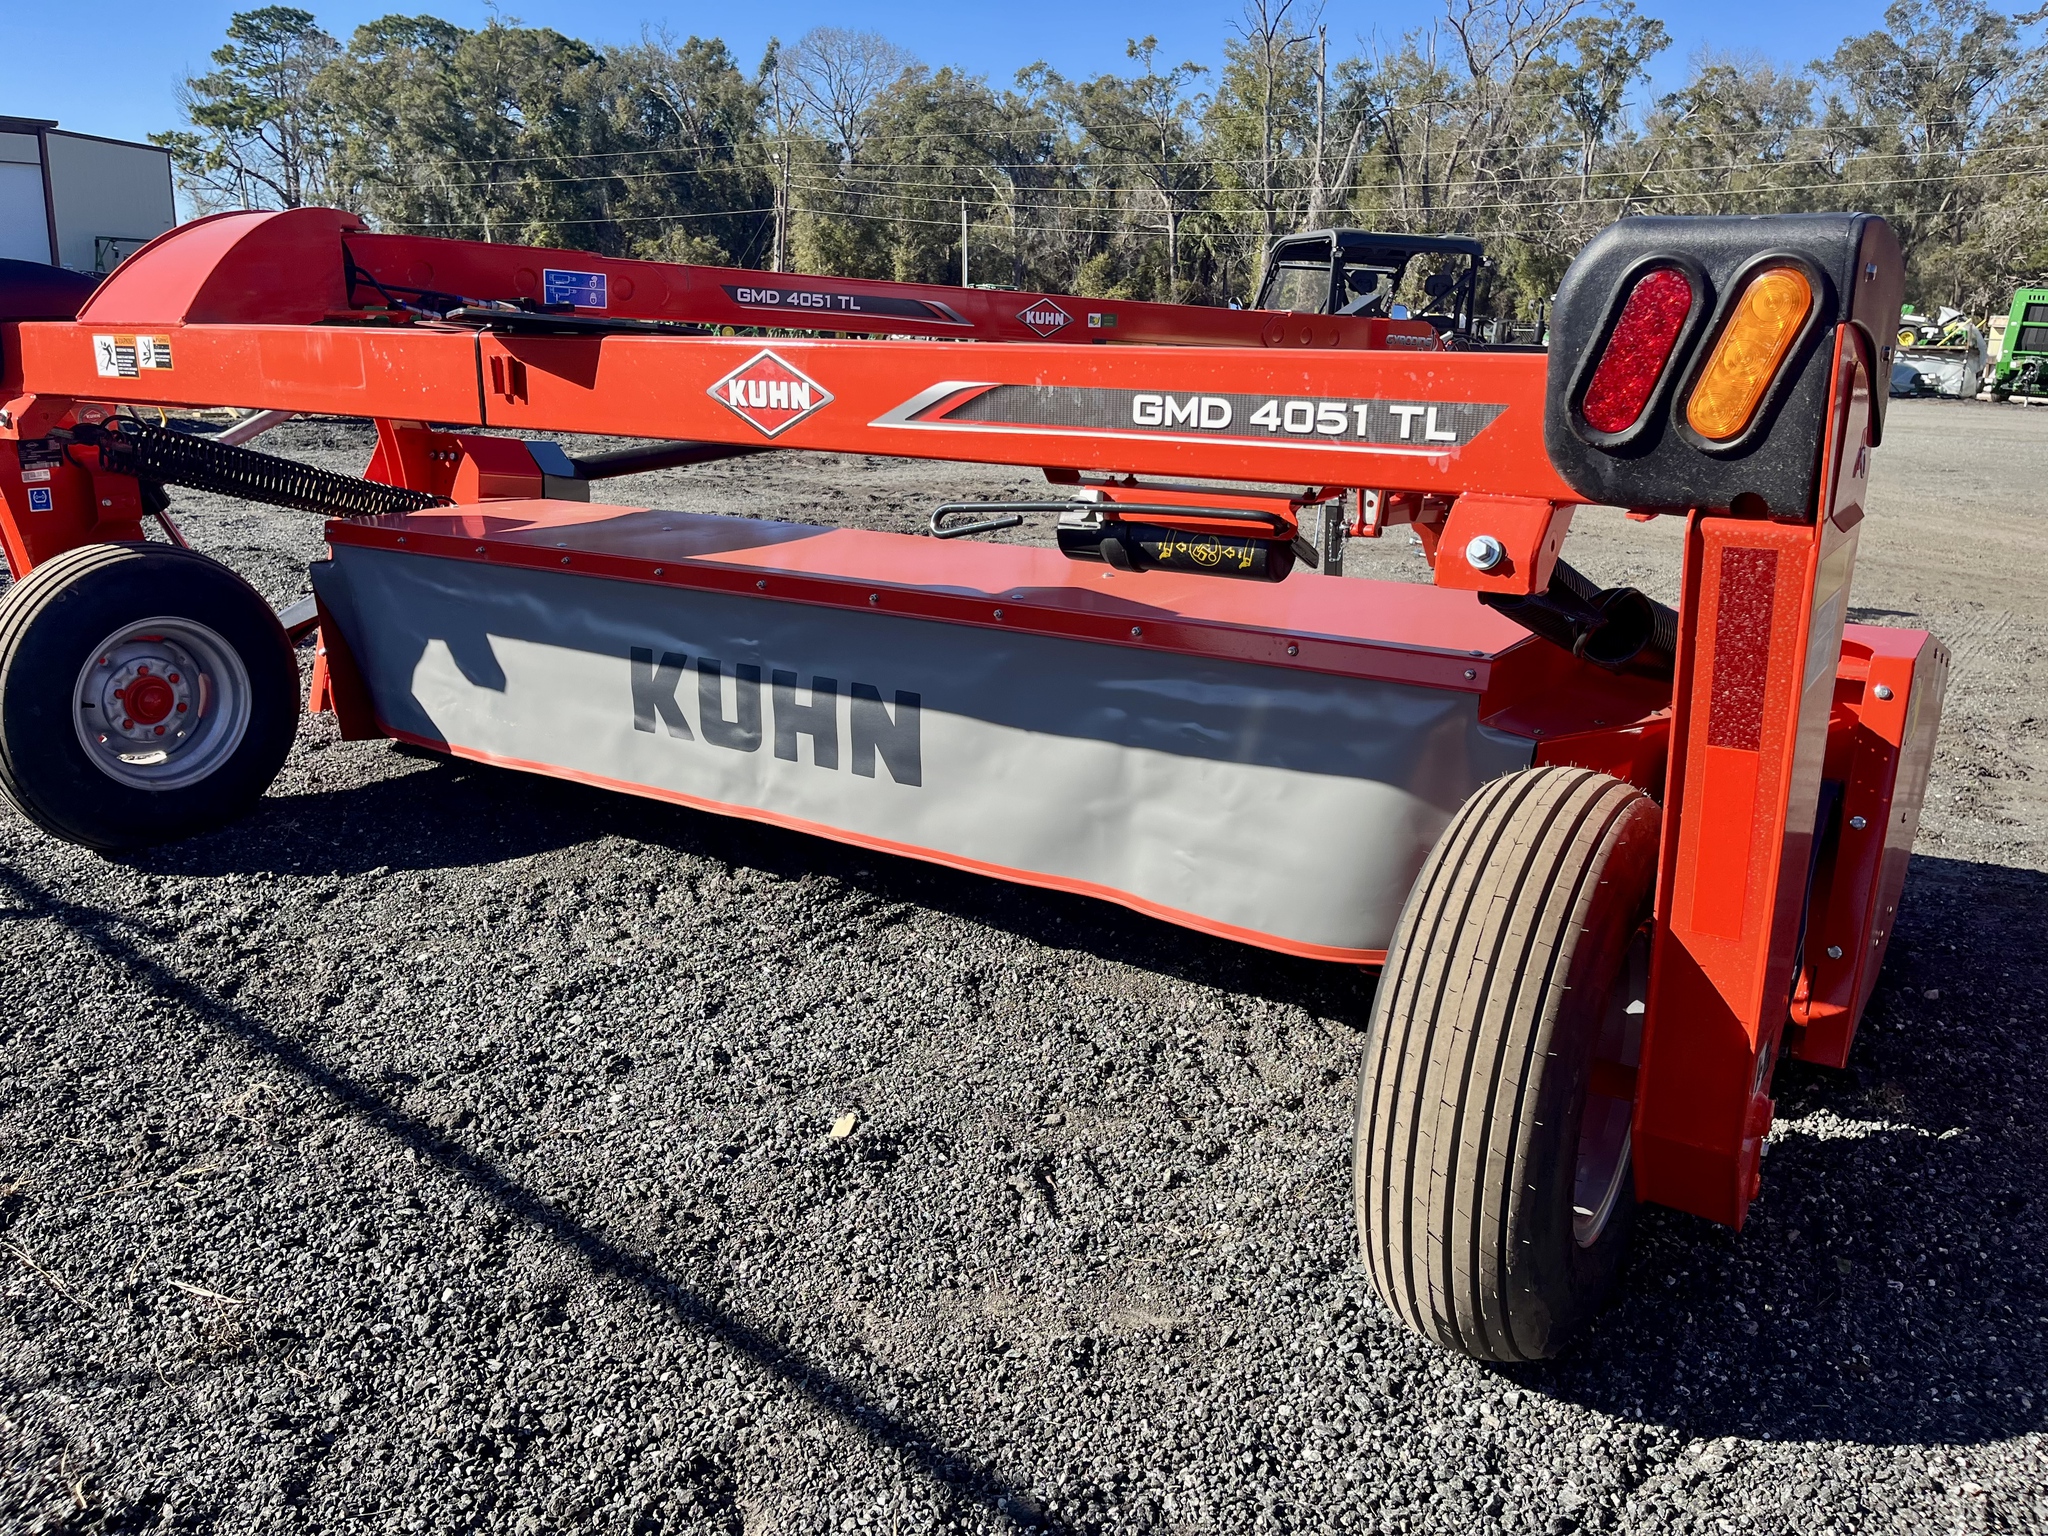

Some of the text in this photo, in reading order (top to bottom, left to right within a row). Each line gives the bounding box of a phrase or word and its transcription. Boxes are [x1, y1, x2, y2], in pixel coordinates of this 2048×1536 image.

[736, 288, 861, 310] GMD 4051 TL
[1025, 310, 1064, 325] KUHN
[728, 379, 811, 410] KUHN
[1132, 394, 1457, 441] GMD 4051 TL
[630, 646, 922, 788] KUHN
